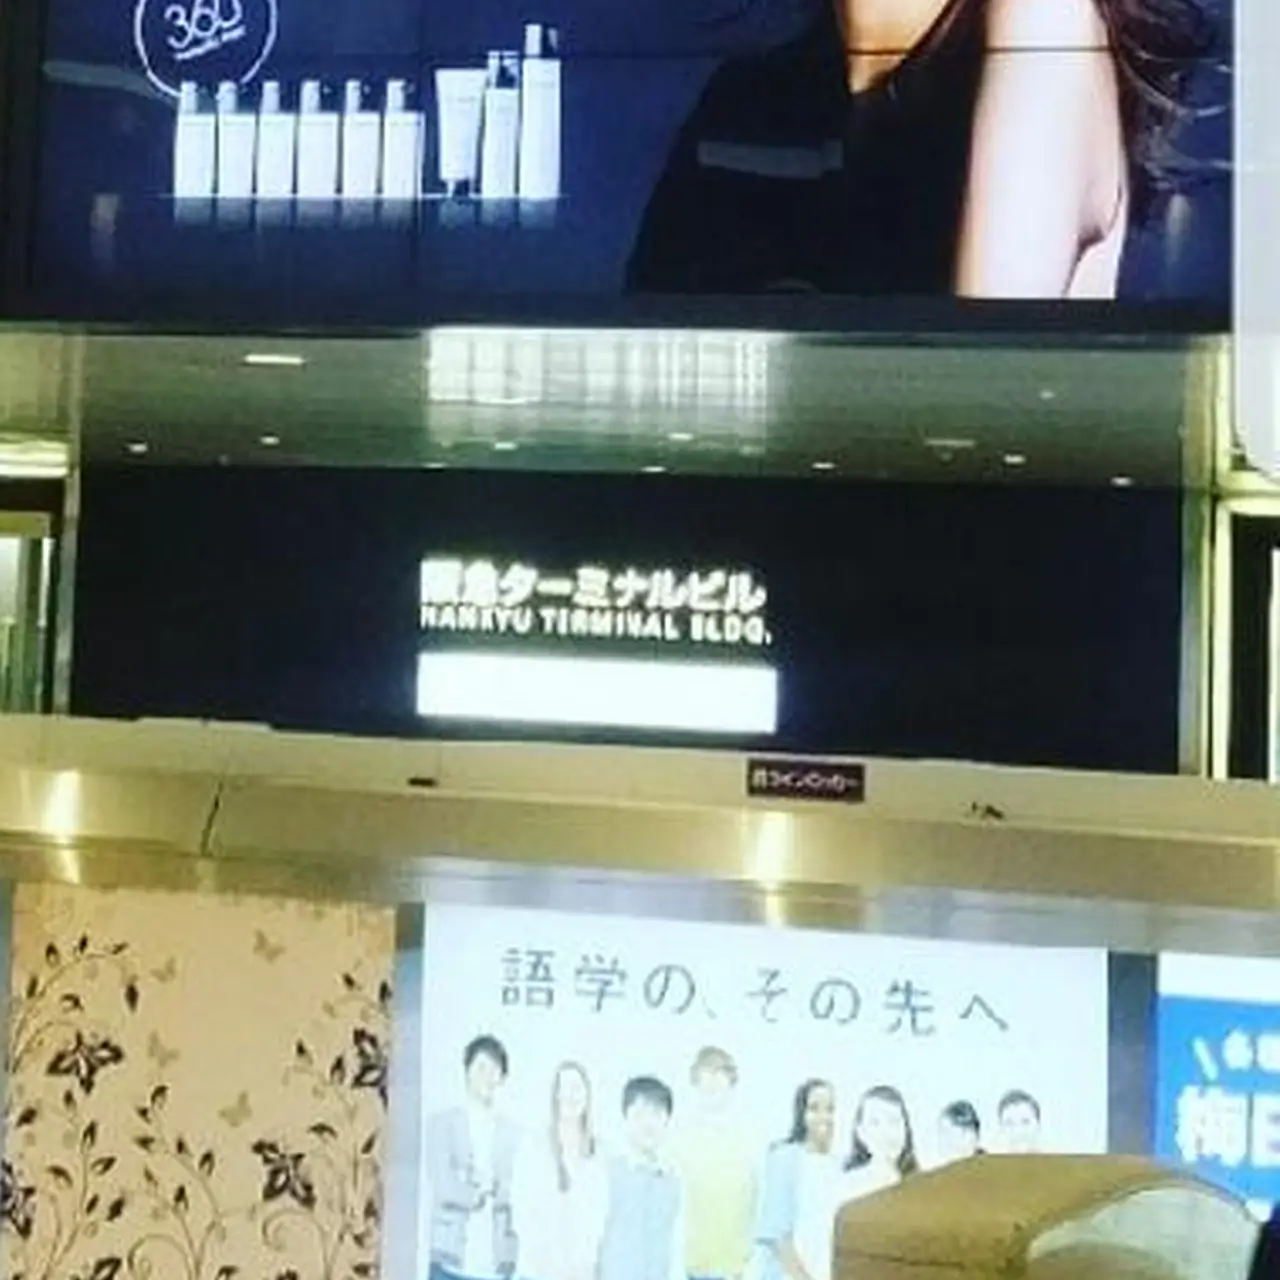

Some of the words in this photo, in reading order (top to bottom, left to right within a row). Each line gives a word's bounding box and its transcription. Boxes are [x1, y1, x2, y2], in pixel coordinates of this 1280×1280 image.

[500, 947, 1010, 1039] 語学の、その先へ
